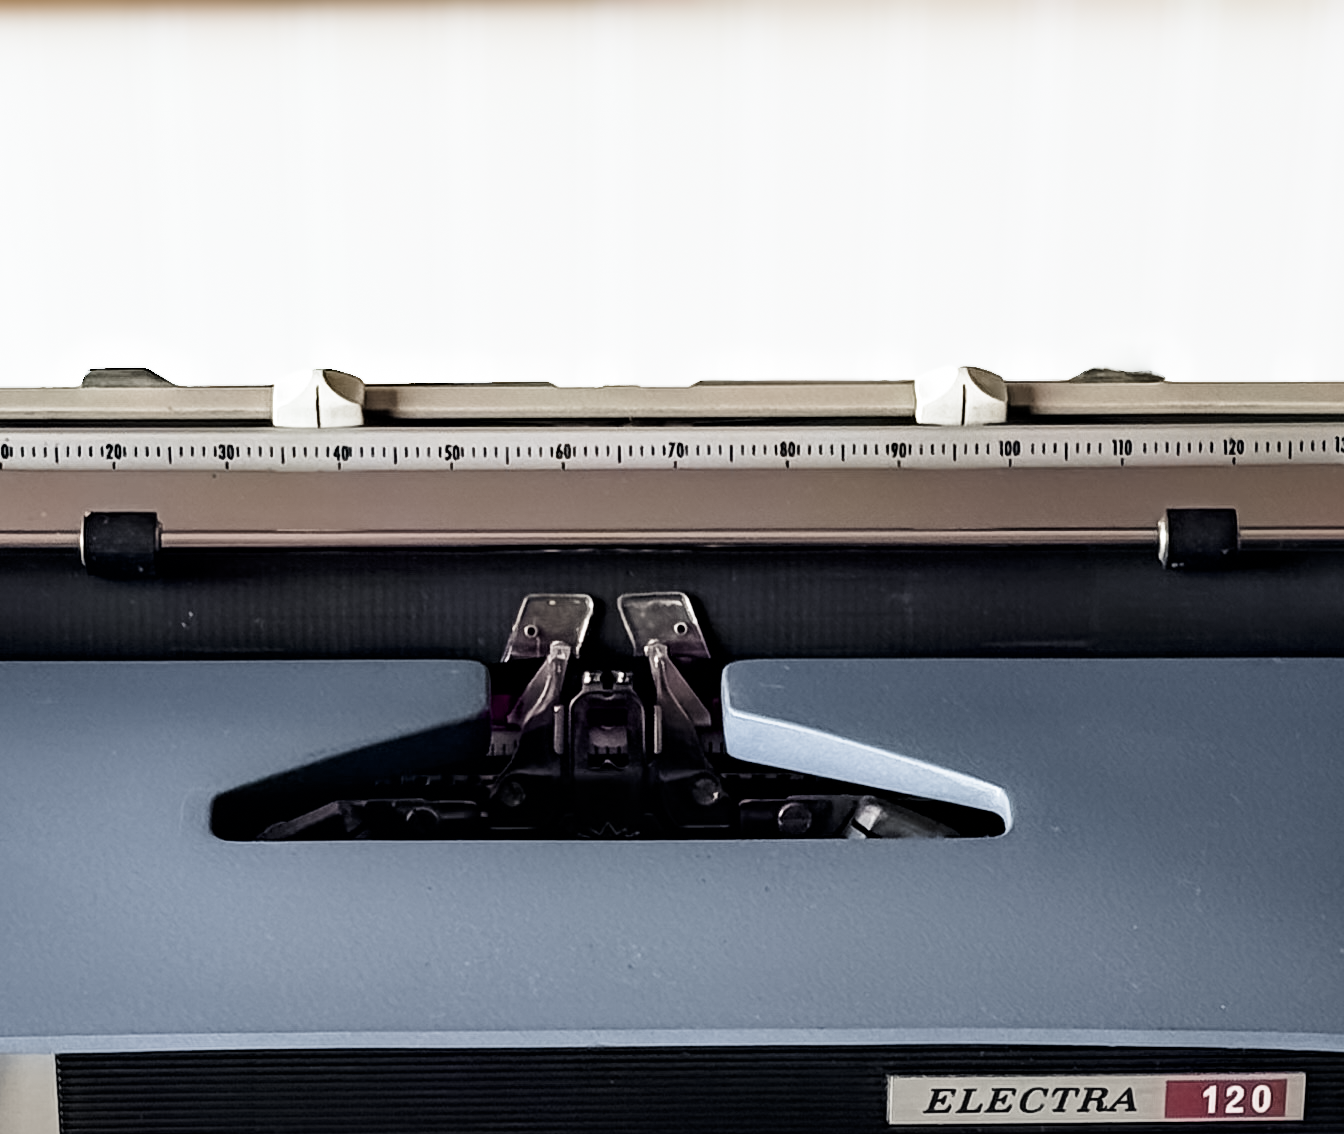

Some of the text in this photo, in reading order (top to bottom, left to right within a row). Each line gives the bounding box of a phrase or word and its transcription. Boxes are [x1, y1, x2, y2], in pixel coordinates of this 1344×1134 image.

[105, 443, 122, 460] 20
[216, 443, 235, 461] 30
[333, 443, 351, 462] 40
[444, 443, 461, 462] 50
[555, 443, 572, 460] 60
[668, 441, 686, 459] 70
[779, 441, 796, 458] 80
[890, 441, 907, 459] 90
[999, 440, 1021, 457] 100
[1112, 439, 1133, 456] 110
[1223, 437, 1245, 456] 120
[922, 1084, 1272, 1114] ELECTRA 120
